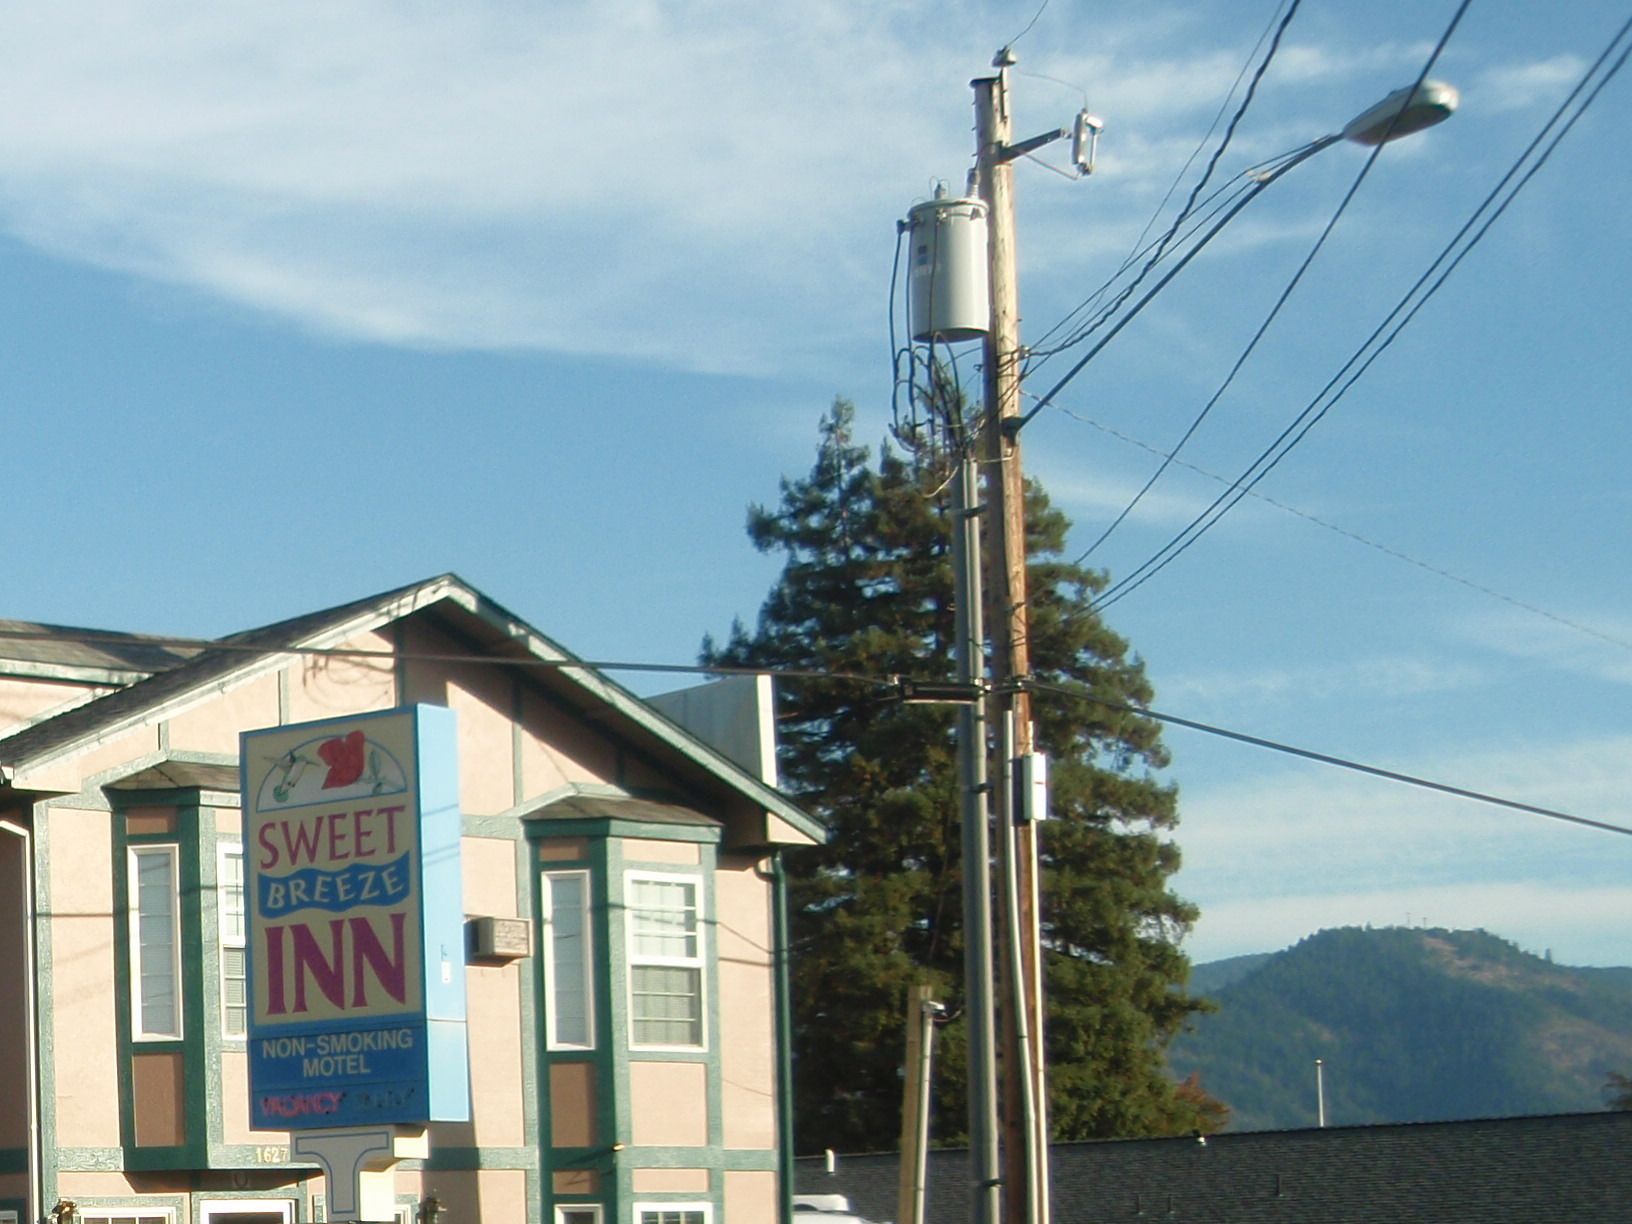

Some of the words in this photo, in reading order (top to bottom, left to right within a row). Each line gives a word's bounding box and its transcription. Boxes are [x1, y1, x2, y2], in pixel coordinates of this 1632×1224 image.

[258, 805, 406, 870] SWEET
[266, 866, 404, 909] BREEZE
[264, 912, 407, 1016] INN
[262, 1029, 414, 1059] NON-SMOKING
[302, 1053, 371, 1078] MOTEL
[260, 1091, 344, 1118] VACANCY
[256, 1146, 289, 1163] 1627
